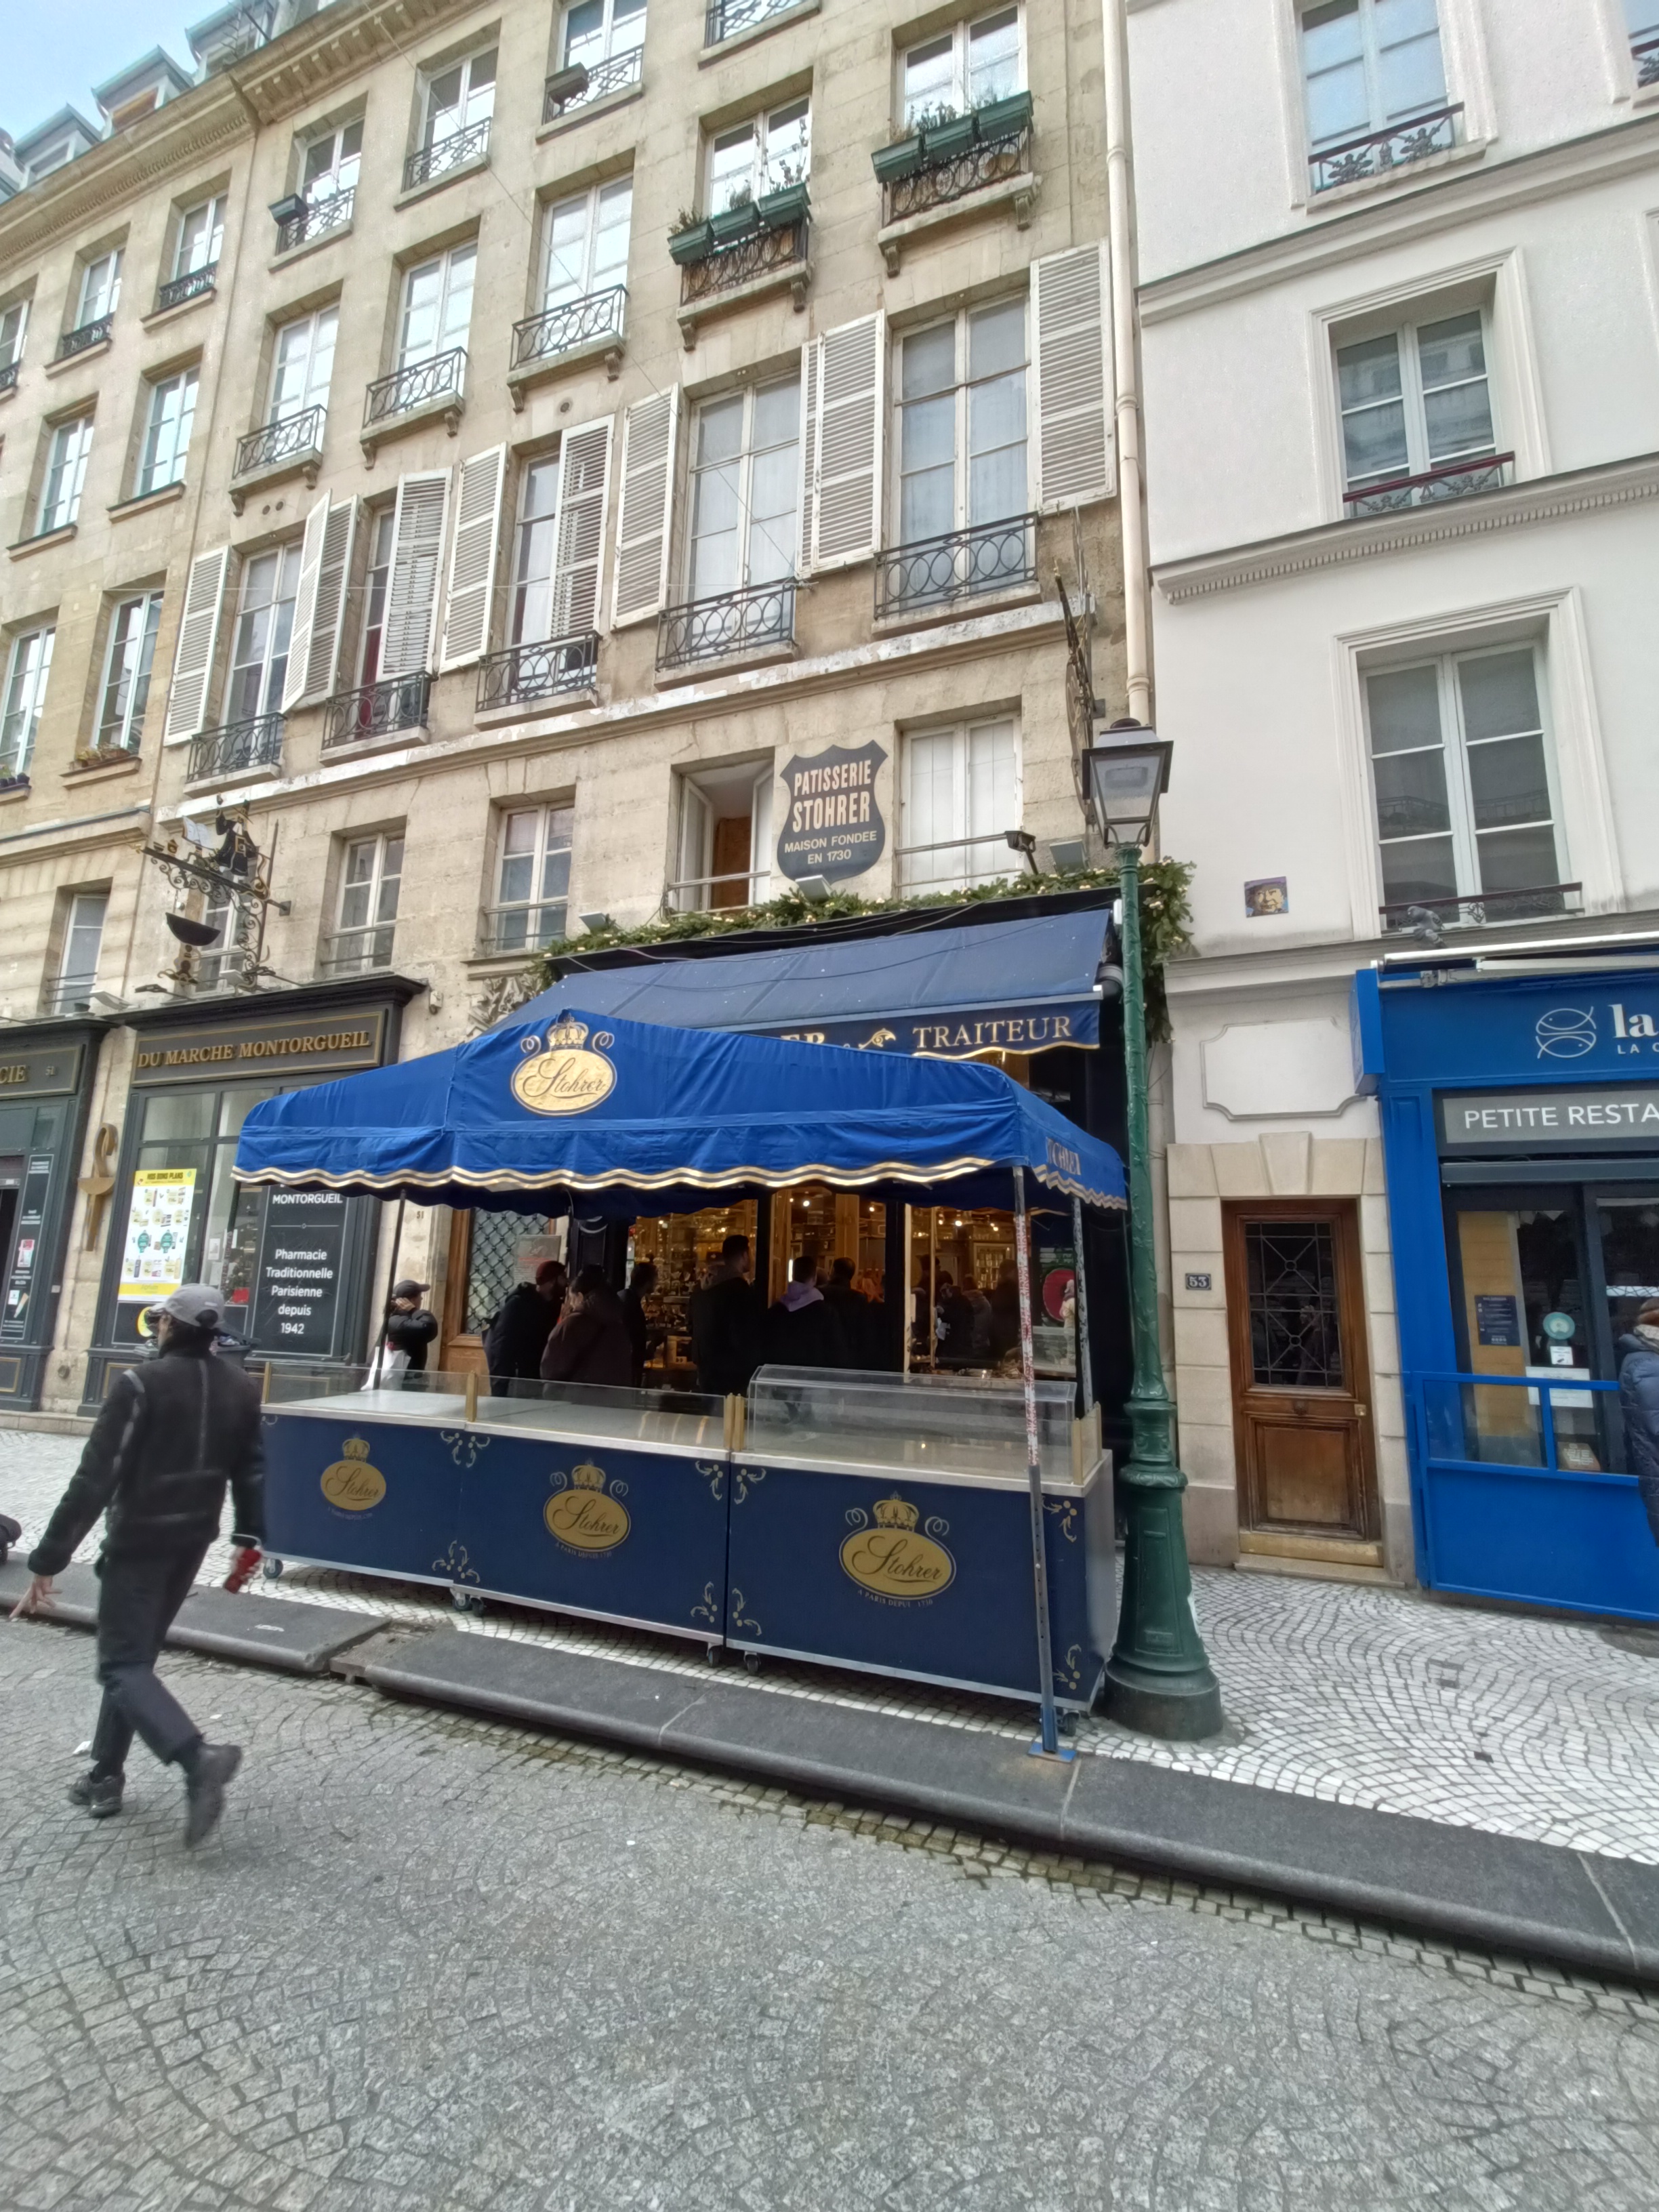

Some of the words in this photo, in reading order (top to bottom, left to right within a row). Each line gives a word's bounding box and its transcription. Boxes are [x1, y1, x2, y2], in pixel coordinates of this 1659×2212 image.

[794, 760, 871, 796] PATISSERIE
[793, 791, 870, 832] STOHRER
[785, 838, 827, 853] MAISON
[832, 830, 877, 846] FONDEE
[808, 853, 822, 864] EN
[827, 849, 851, 861] 1730
[1607, 1004, 1659, 1038] la
[912, 1016, 1071, 1048] TRAITEUR
[138, 1052, 161, 1067] DU
[165, 1044, 233, 1065] MARCHE
[239, 1030, 370, 1058] MONTORGUEIL
[1617, 1044, 1640, 1054] LA
[0, 1065, 26, 1084] CIE
[523, 1057, 605, 1098] Stohrer
[1464, 1107, 1559, 1129] PETITE
[1568, 1103, 1659, 1125] RESTA
[272, 1193, 343, 1204] MONTORGUEIL
[274, 1249, 327, 1260] Pharmacie
[266, 1267, 333, 1279] Traditionnelle
[1189, 1276, 1206, 1287] 53
[271, 1286, 323, 1297] Parisienne
[278, 1305, 312, 1316] depuis
[281, 1323, 304, 1334] 1942
[552, 1496, 620, 1534] Stohrer
[851, 1535, 943, 1580] Stohrer
[865, 1591, 886, 1604] PARIS
